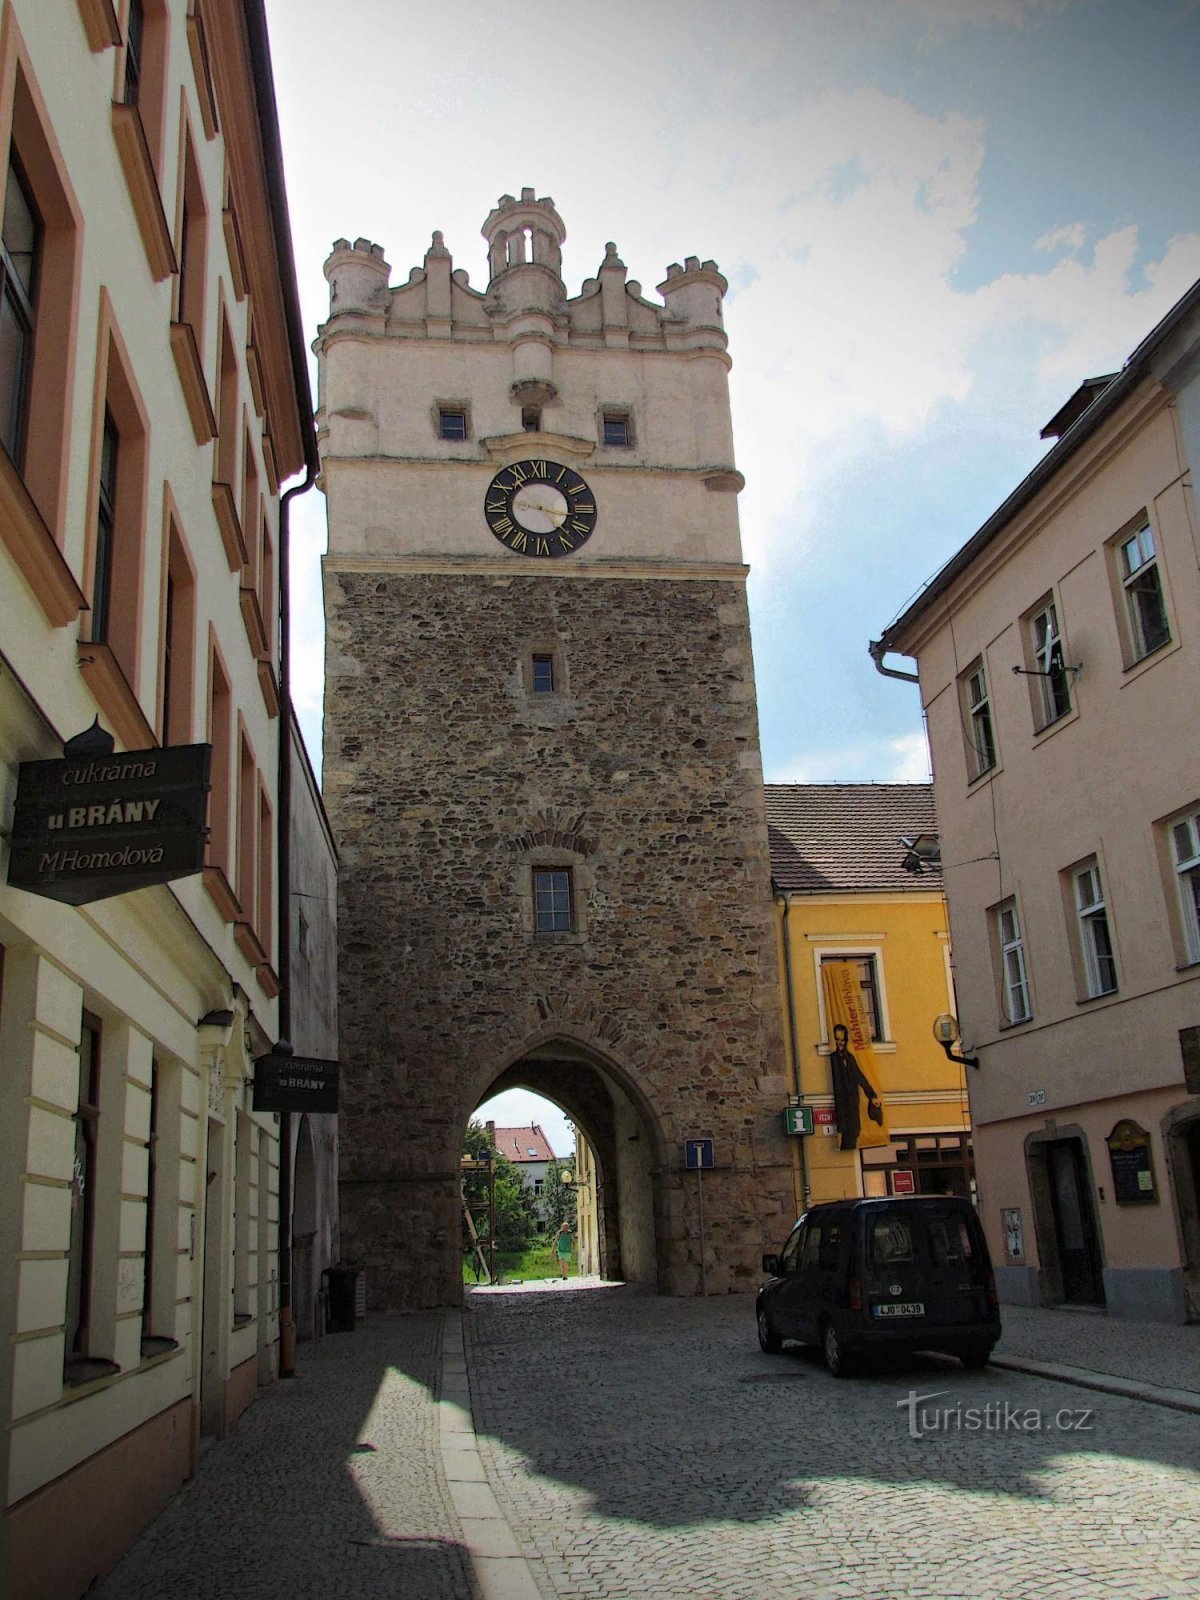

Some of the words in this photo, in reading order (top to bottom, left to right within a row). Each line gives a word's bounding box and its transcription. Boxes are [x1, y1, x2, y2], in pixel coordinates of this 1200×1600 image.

[531, 461, 547, 479] XII
[555, 467, 566, 483] I
[492, 479, 513, 495] X
[567, 483, 587, 496] II
[574, 504, 595, 514] III
[63, 761, 156, 785] cukrárna
[48, 814, 64, 830] u
[68, 799, 161, 829] BRÁNY
[848, 1006, 864, 1051] Mahler
